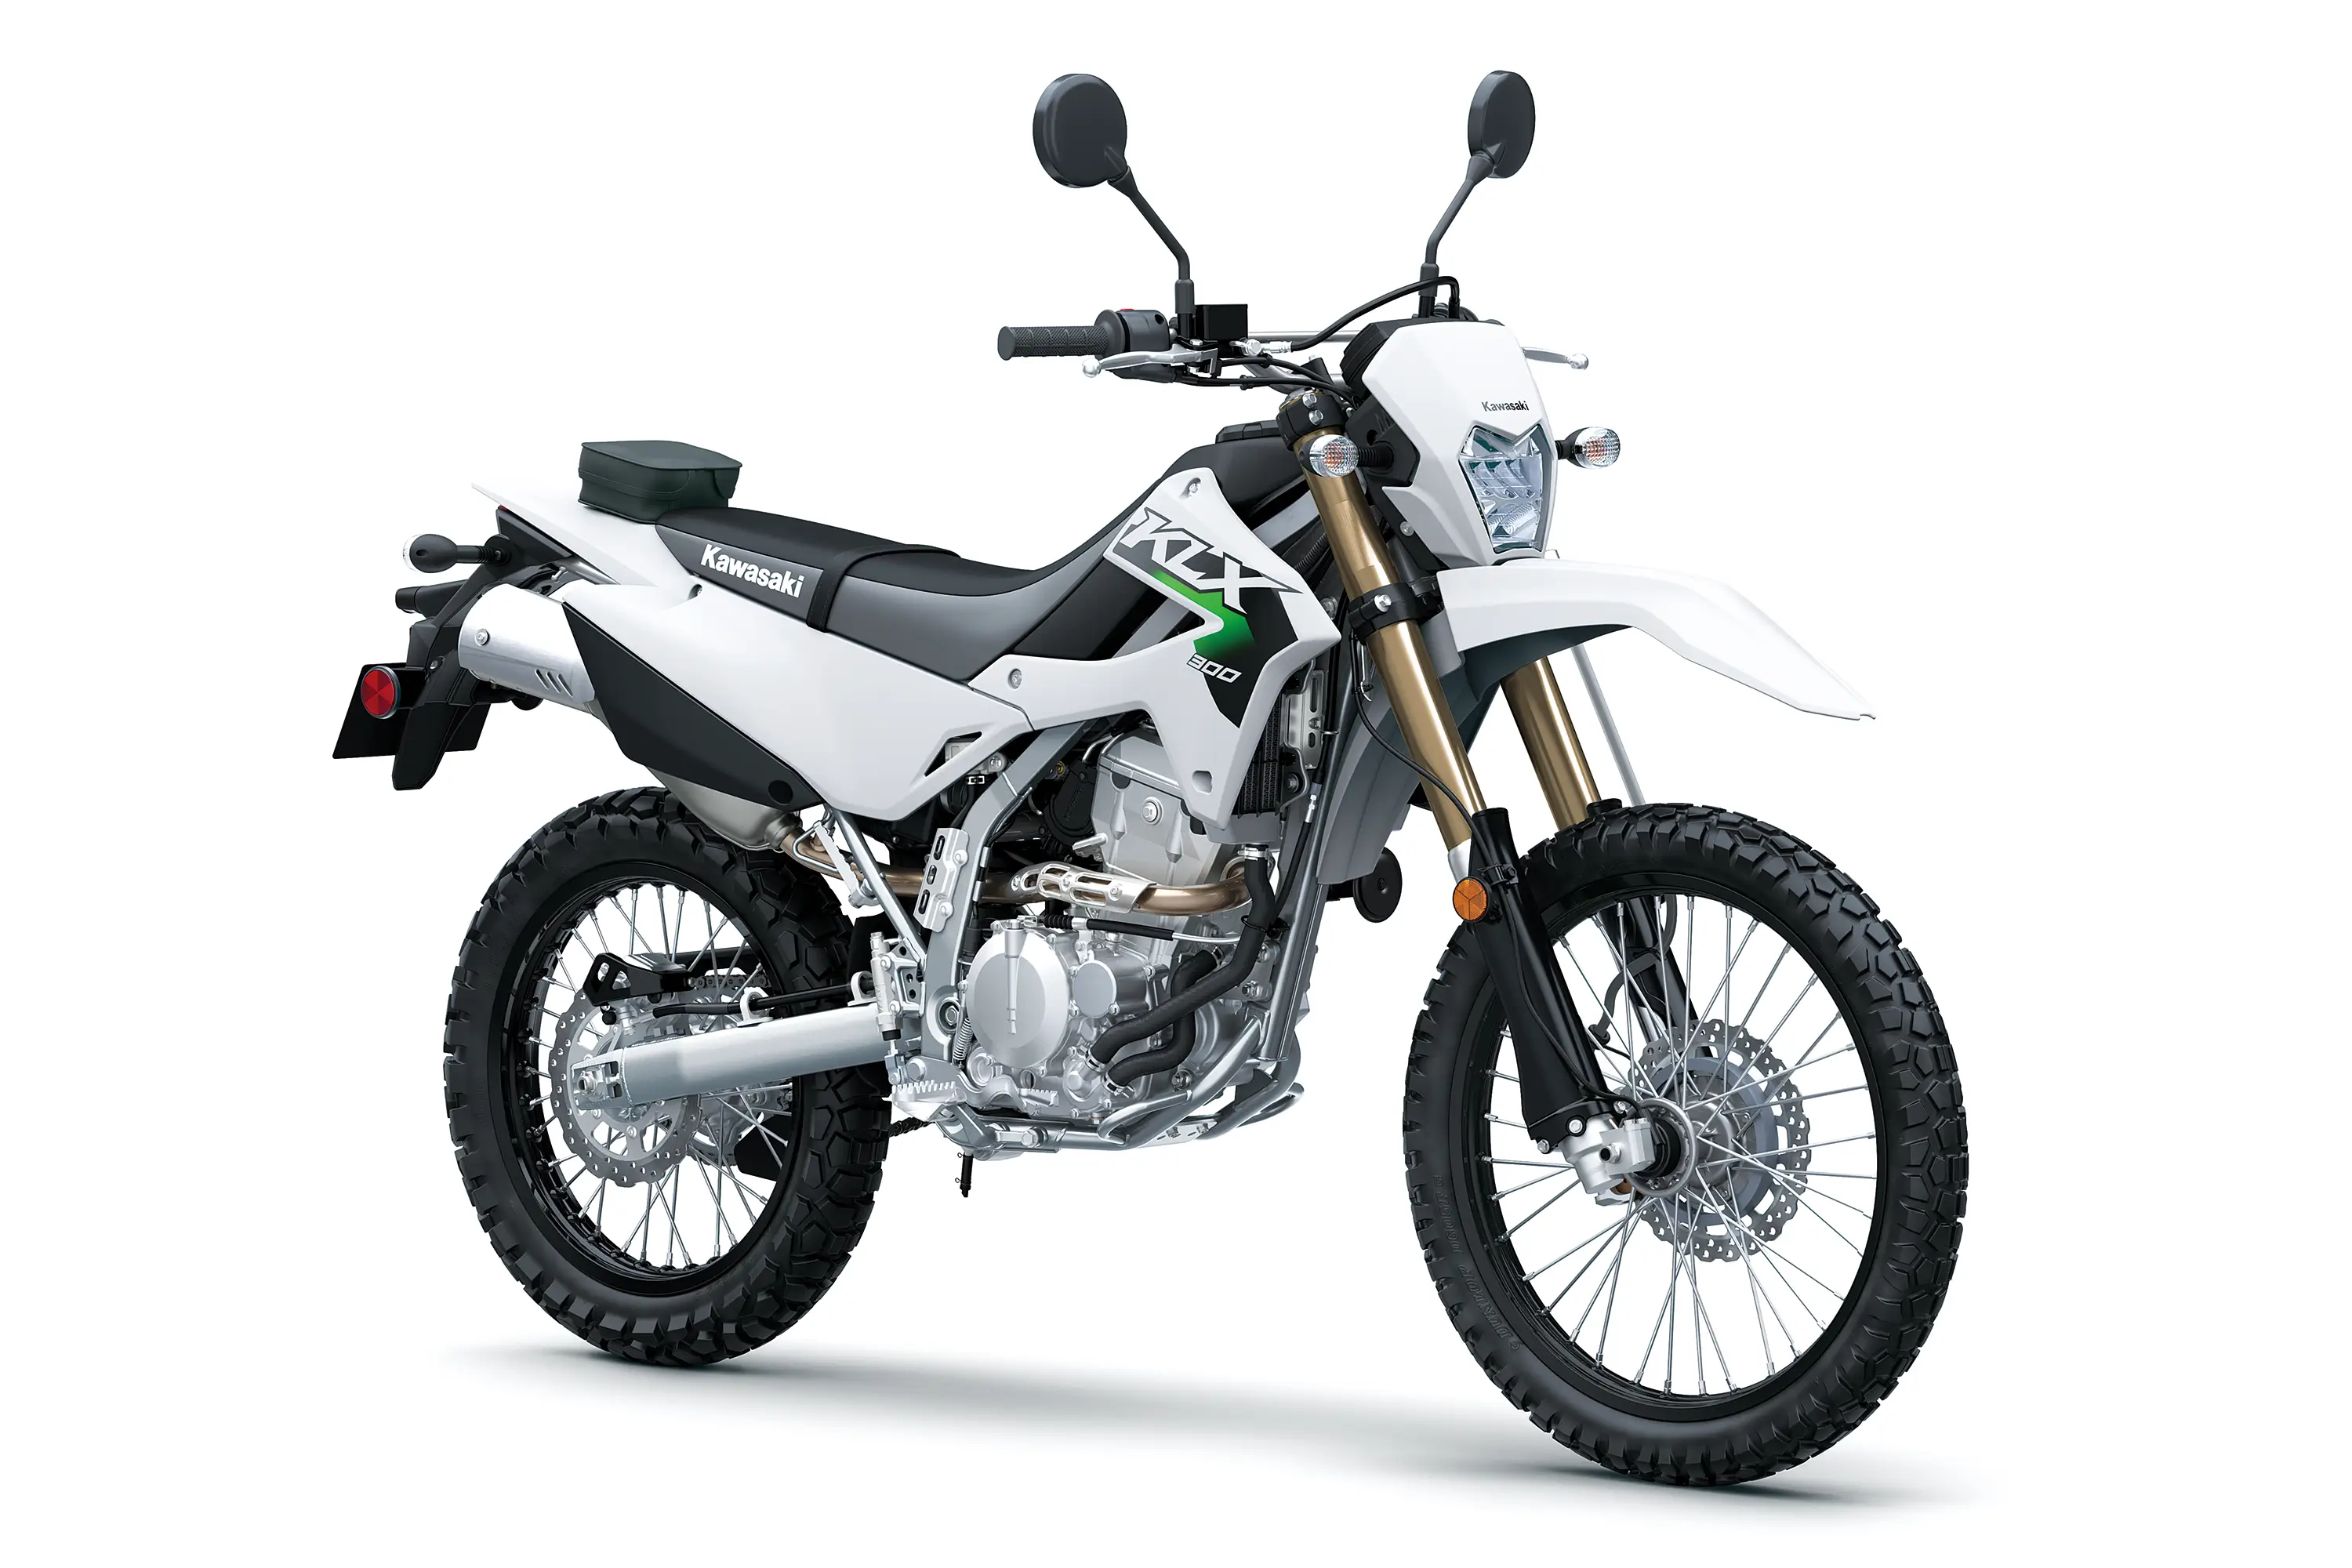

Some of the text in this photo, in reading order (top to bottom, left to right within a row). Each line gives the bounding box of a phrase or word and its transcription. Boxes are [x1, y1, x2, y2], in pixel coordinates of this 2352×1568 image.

[1481, 400, 1530, 412] Kawasaki
[700, 543, 805, 598] Kawasaki
[1119, 506, 1304, 617] KLX
[1186, 653, 1242, 683] 300
[1458, 1264, 1513, 1339] DUNLOP
